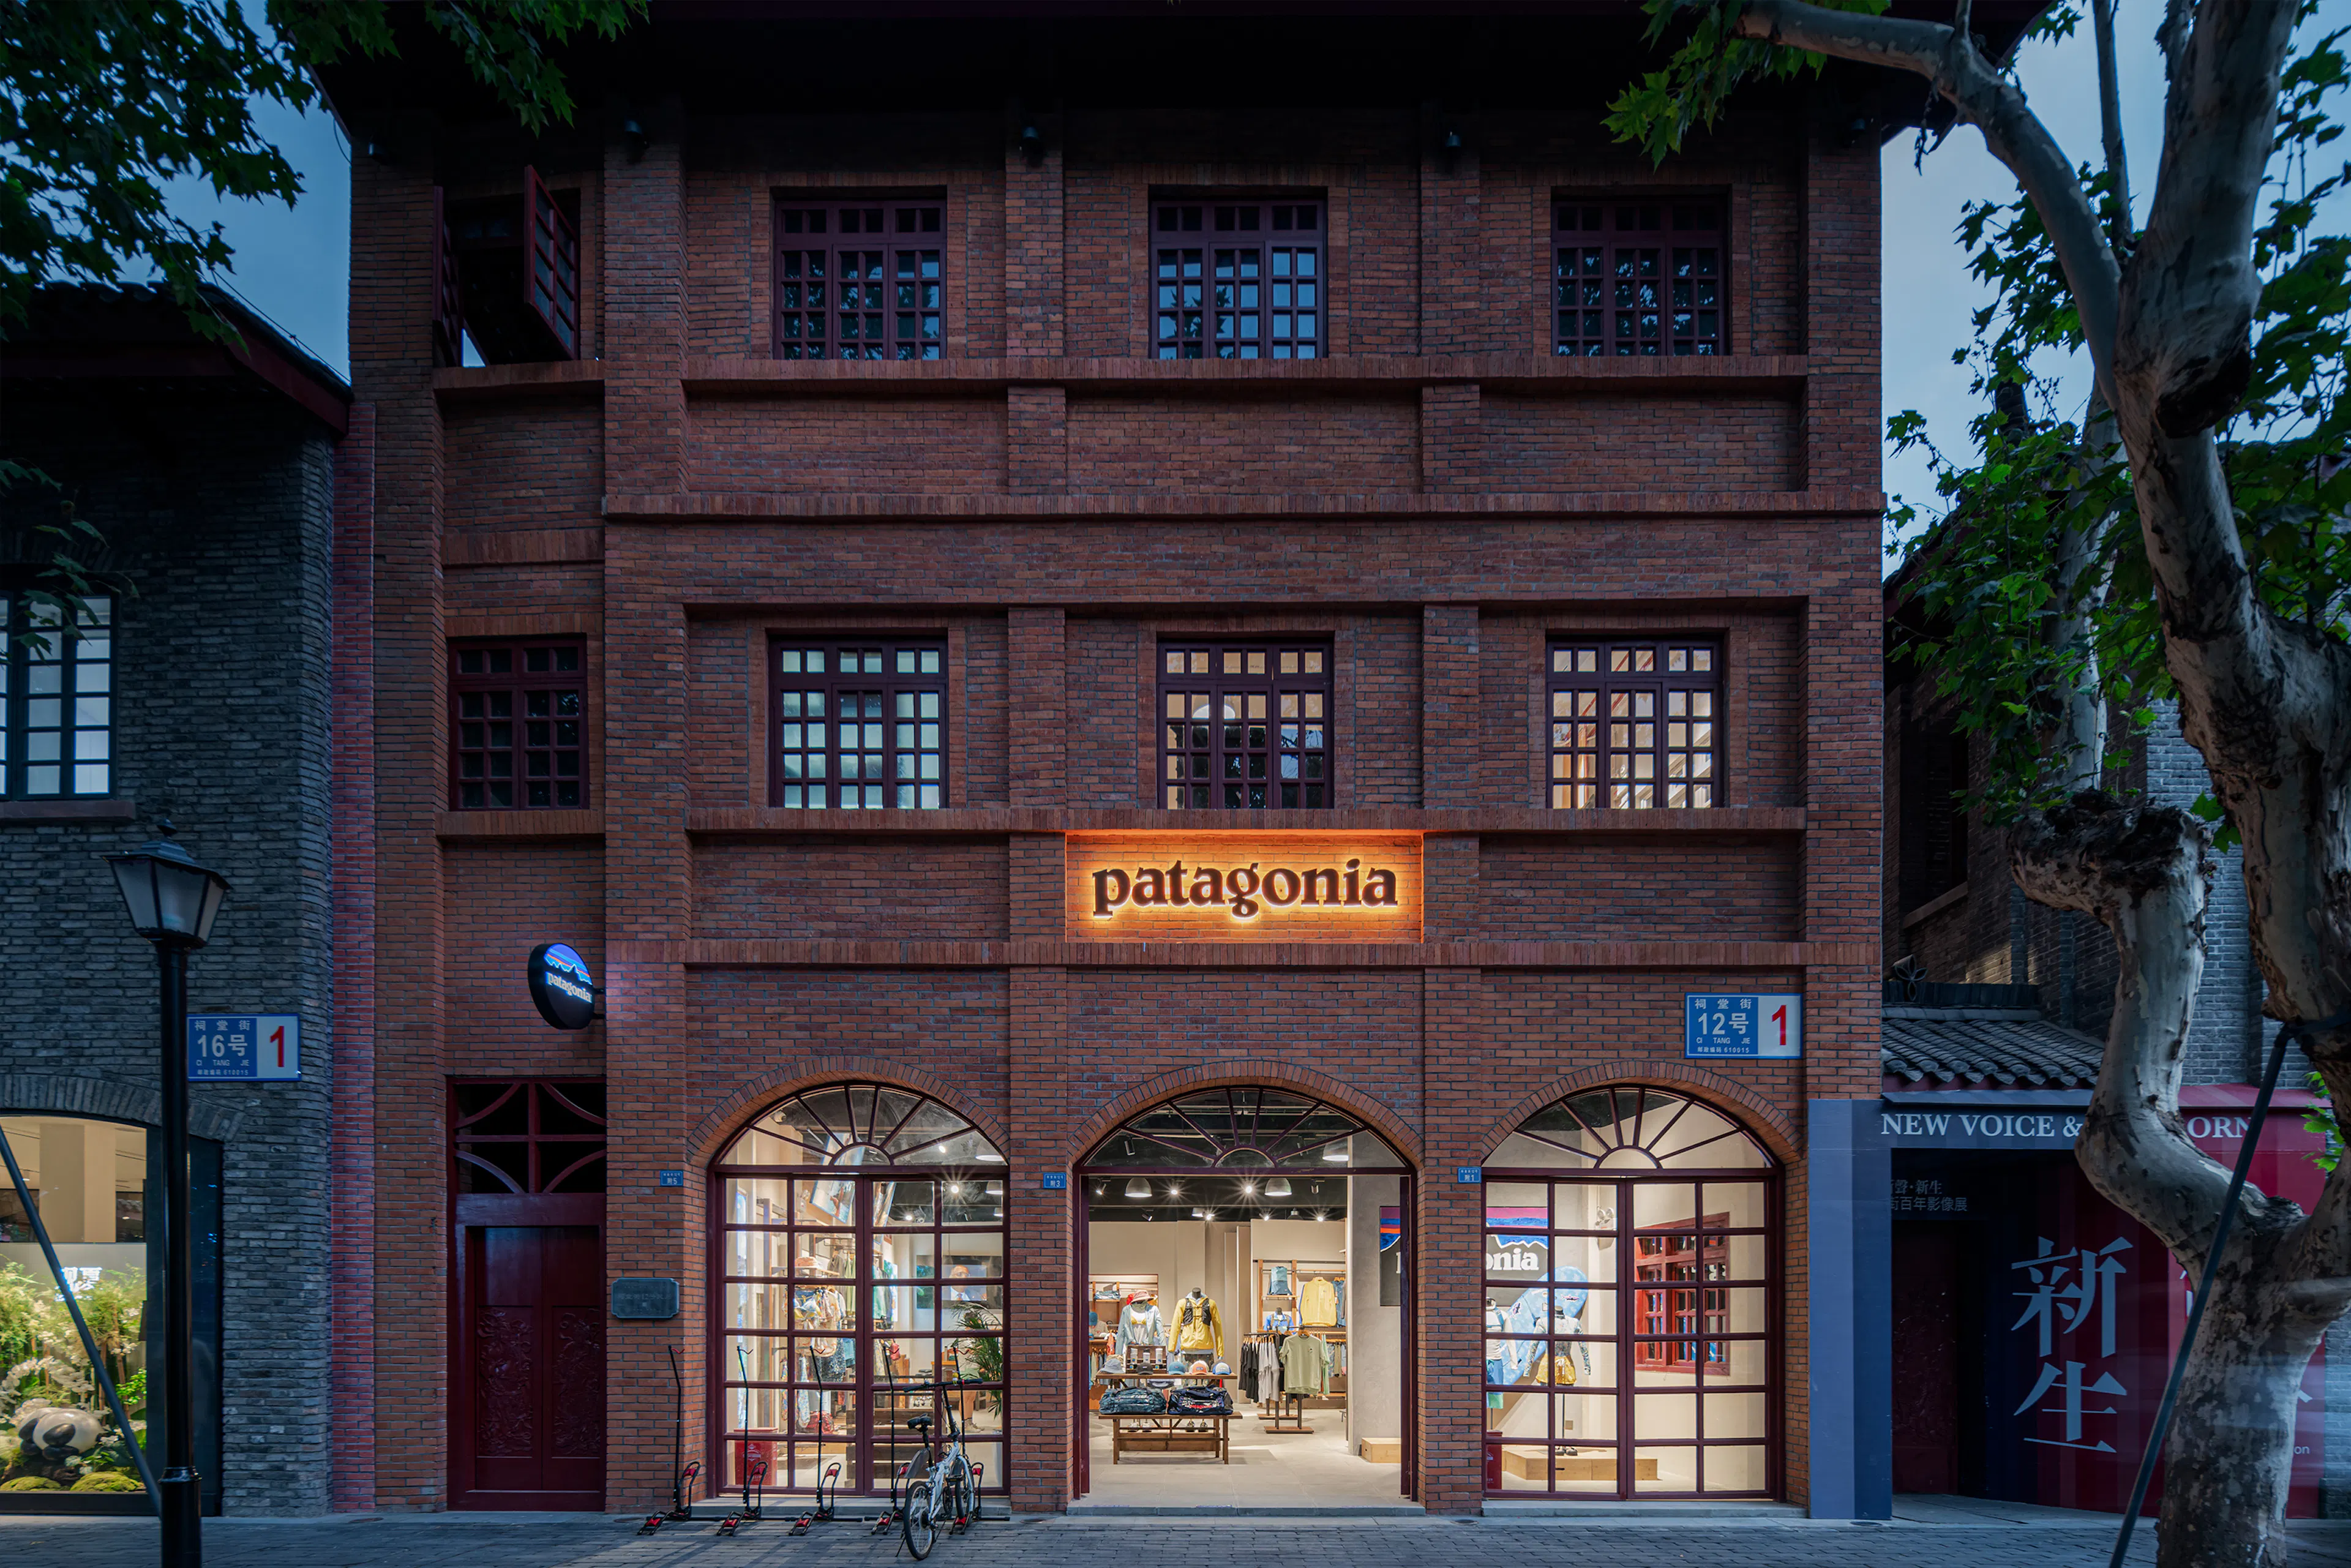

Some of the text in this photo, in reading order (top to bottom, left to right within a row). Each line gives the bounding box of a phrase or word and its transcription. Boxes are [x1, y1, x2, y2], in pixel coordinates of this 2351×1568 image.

[1093, 859, 1398, 917] patagonia
[546, 972, 593, 1003] patagonia
[1694, 998, 1752, 1010] 祠堂街
[194, 1019, 251, 1031] 祠堂街
[1697, 1012, 1749, 1035] 12号
[1772, 1005, 1786, 1045] 1
[197, 1034, 248, 1057] 16号
[270, 1026, 284, 1067] 1
[1880, 1113, 2252, 1139] NEW VOICE & ORN
[1891, 1179, 1943, 1195] 聲·新生
[2010, 1235, 2134, 1454] 新生
